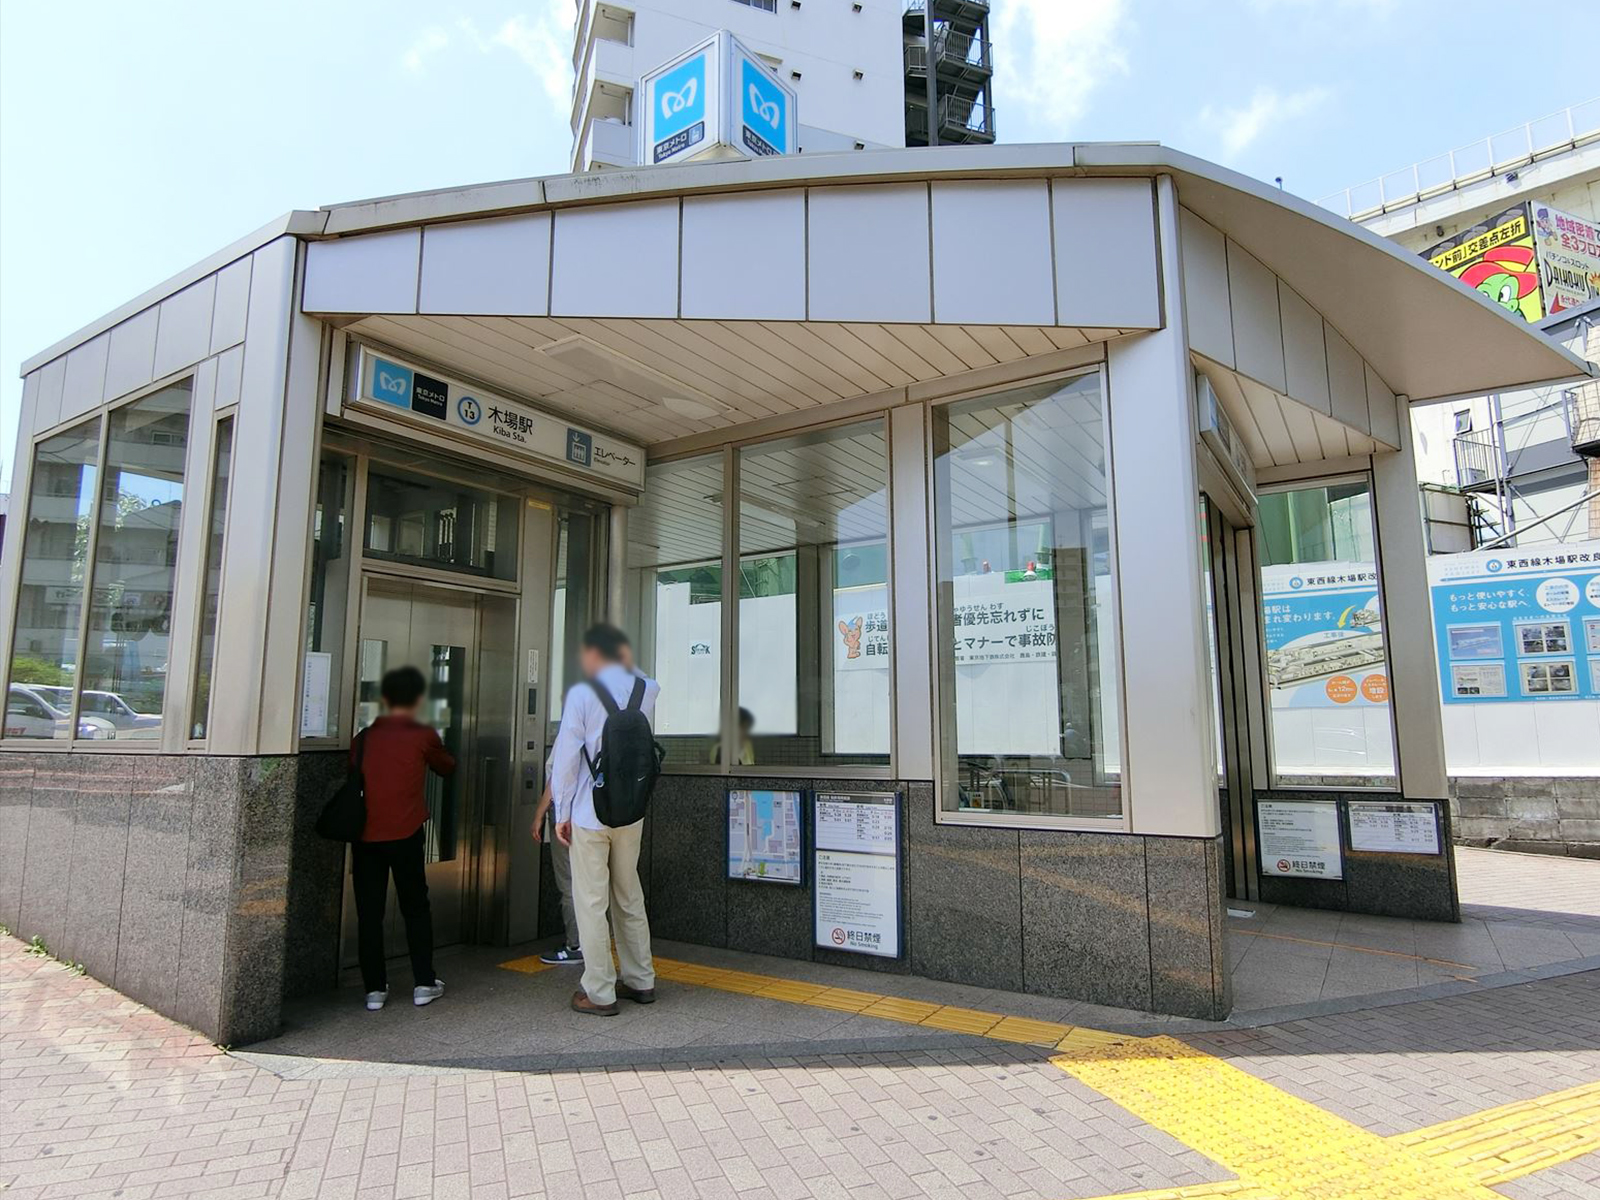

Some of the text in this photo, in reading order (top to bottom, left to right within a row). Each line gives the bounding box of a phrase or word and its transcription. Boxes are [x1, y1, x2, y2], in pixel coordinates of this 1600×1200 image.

[656, 132, 687, 154] 東京メトロ
[415, 386, 446, 402] 東京メトロ
[467, 401, 473, 410] T
[464, 409, 475, 420] 13
[488, 406, 534, 435] 木場駅
[493, 425, 527, 444] Kiba Sta.
[594, 446, 636, 466] エレベーター
[865, 619, 888, 633] 歩道
[866, 643, 889, 656] 自転
[1292, 861, 1326, 870] 終日禁煙
[847, 930, 881, 944] 終日禁煙
[858, 941, 879, 950] Smoking
